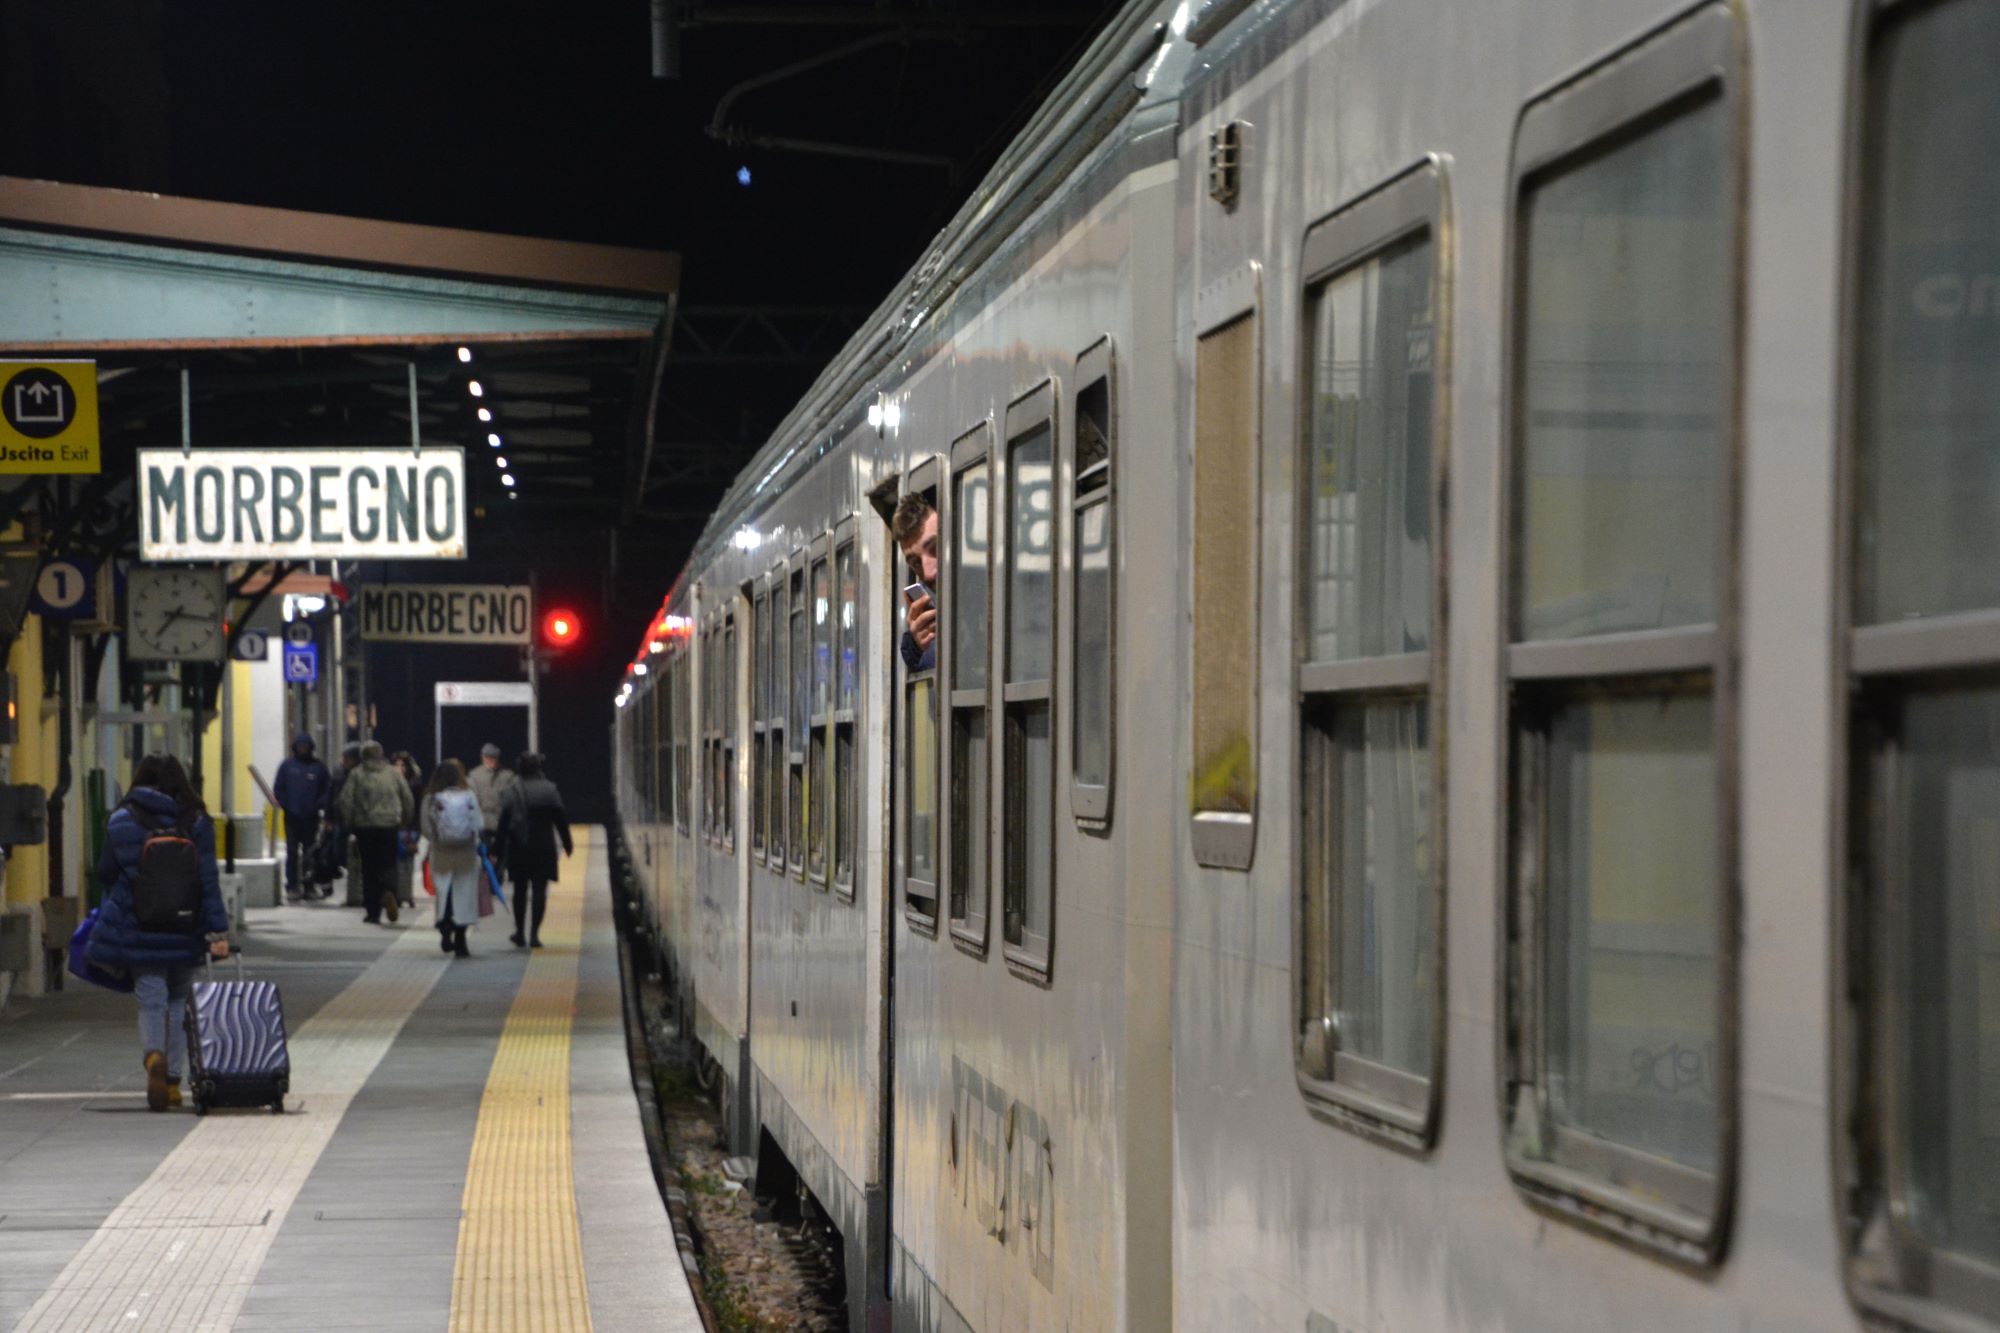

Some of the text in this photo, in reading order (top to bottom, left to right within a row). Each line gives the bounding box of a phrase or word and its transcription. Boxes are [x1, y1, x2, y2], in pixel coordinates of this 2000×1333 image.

[61, 445, 88, 461] Exit
[148, 465, 456, 544] MORBEGNO
[53, 571, 66, 599] 1
[364, 590, 527, 635] MORBEGNO
